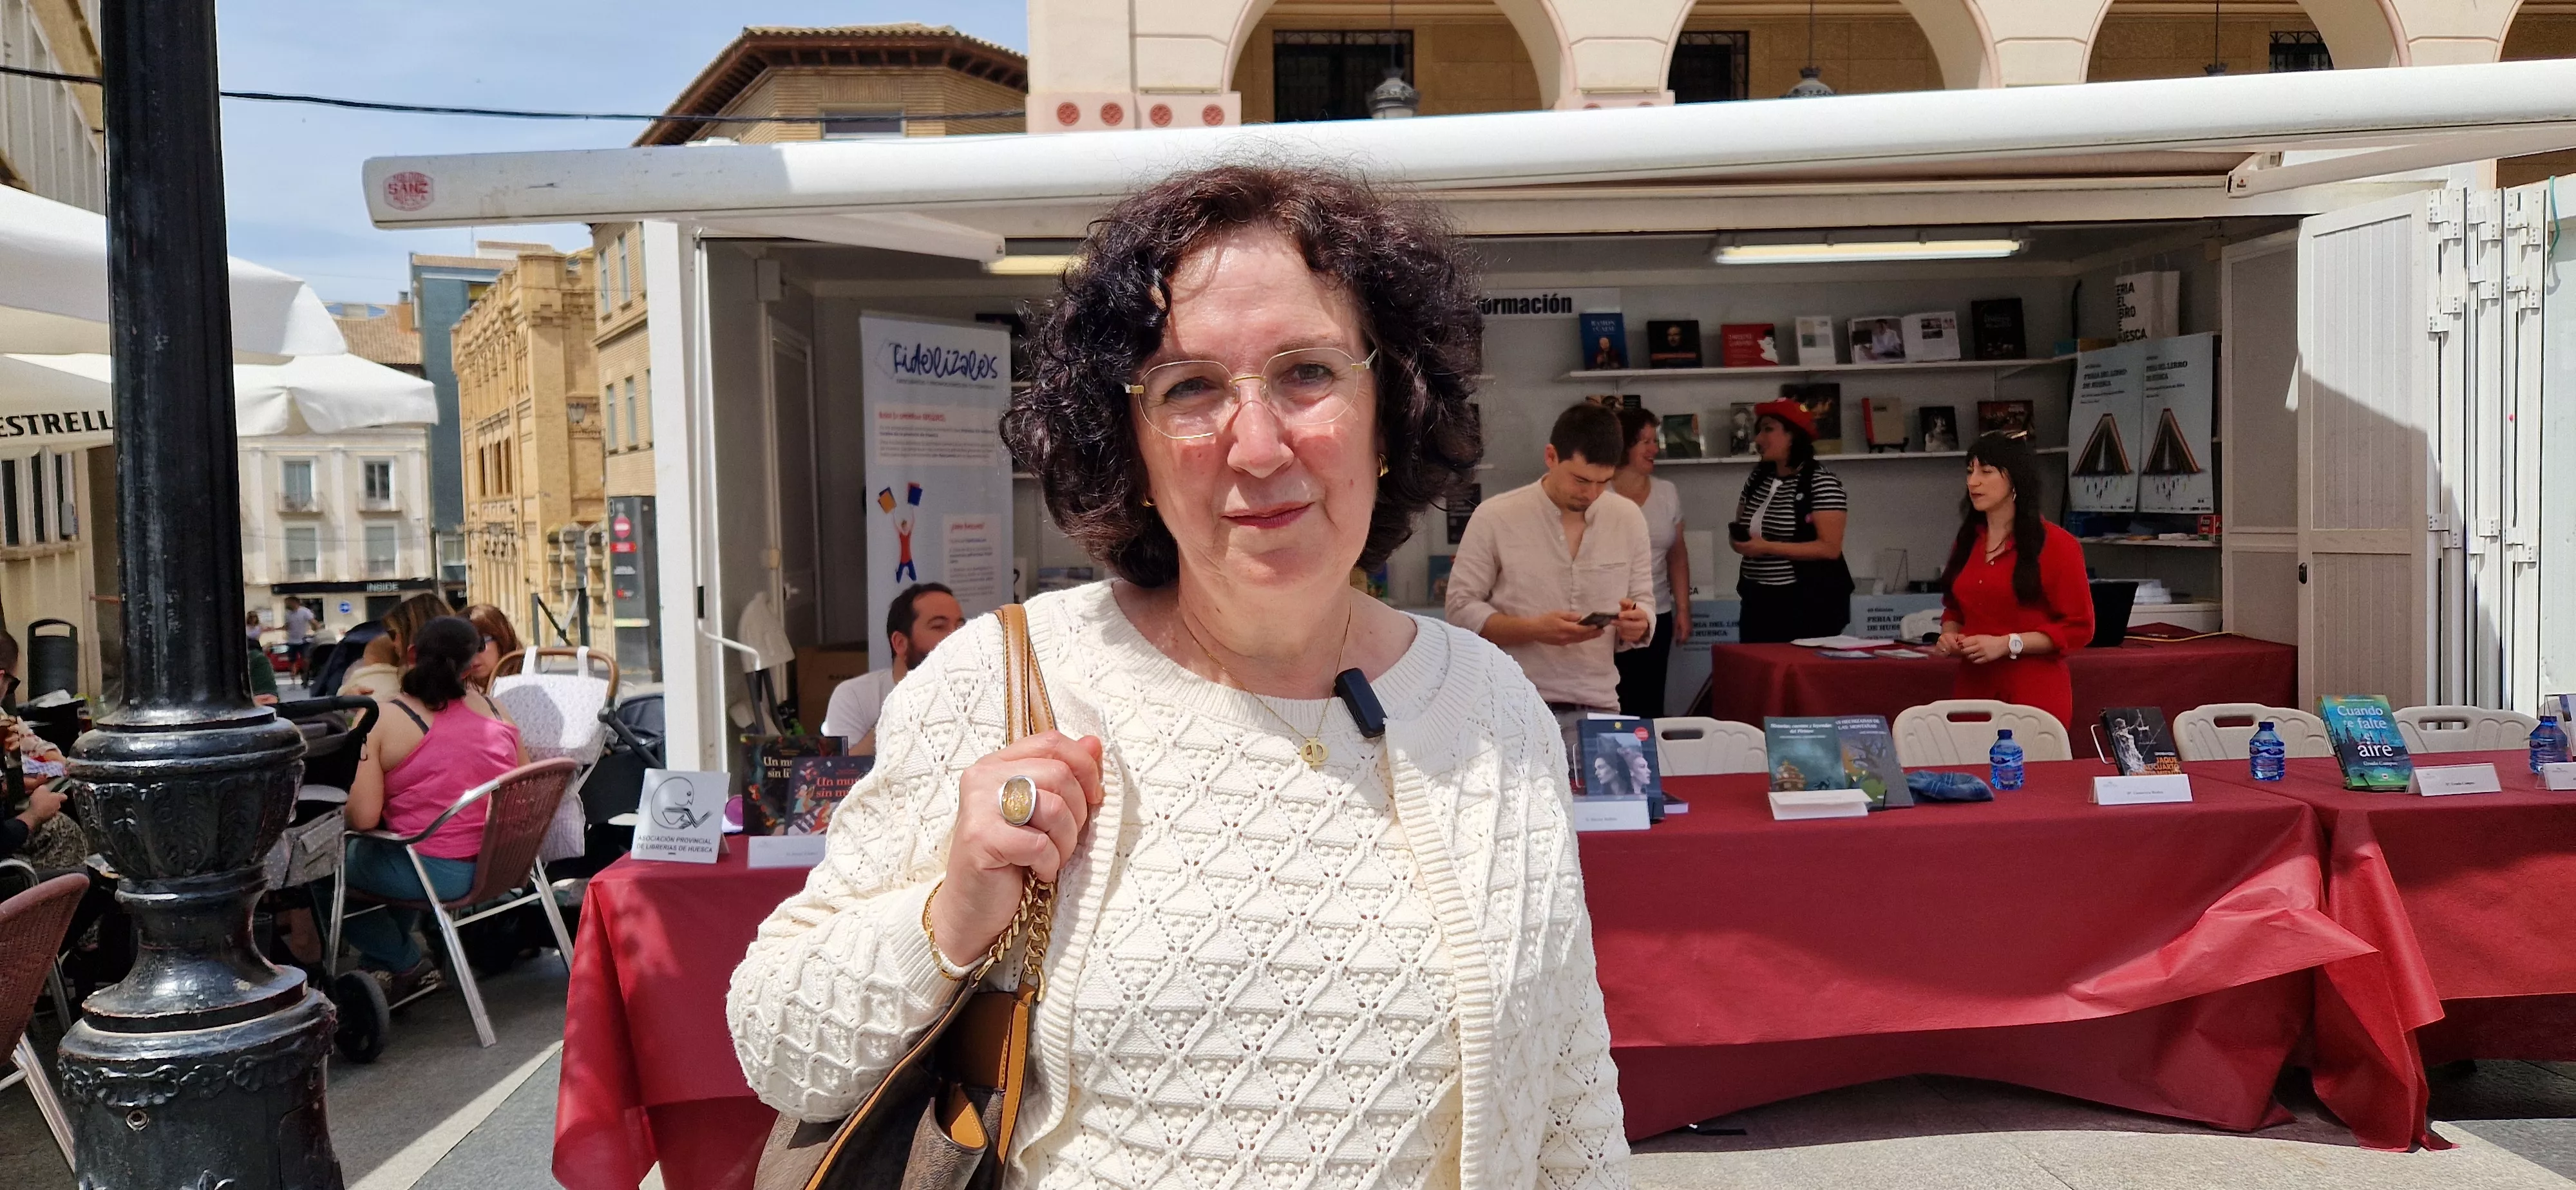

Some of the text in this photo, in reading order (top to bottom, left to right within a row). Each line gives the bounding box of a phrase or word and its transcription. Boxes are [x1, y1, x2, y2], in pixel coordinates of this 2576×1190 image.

[388, 182, 428, 194] SANZ
[1479, 292, 1573, 314] ormación
[366, 581, 399, 592] INSIDE
[2336, 704, 2383, 716] Cuando
[2357, 717, 2387, 730] falte
[2357, 741, 2394, 757] aire
[763, 756, 779, 766] Un
[768, 768, 781, 778] sin
[817, 777, 834, 787] Un
[816, 788, 832, 798] sin
[638, 835, 712, 845] ASOCIACIÓN PROVINCIAL
